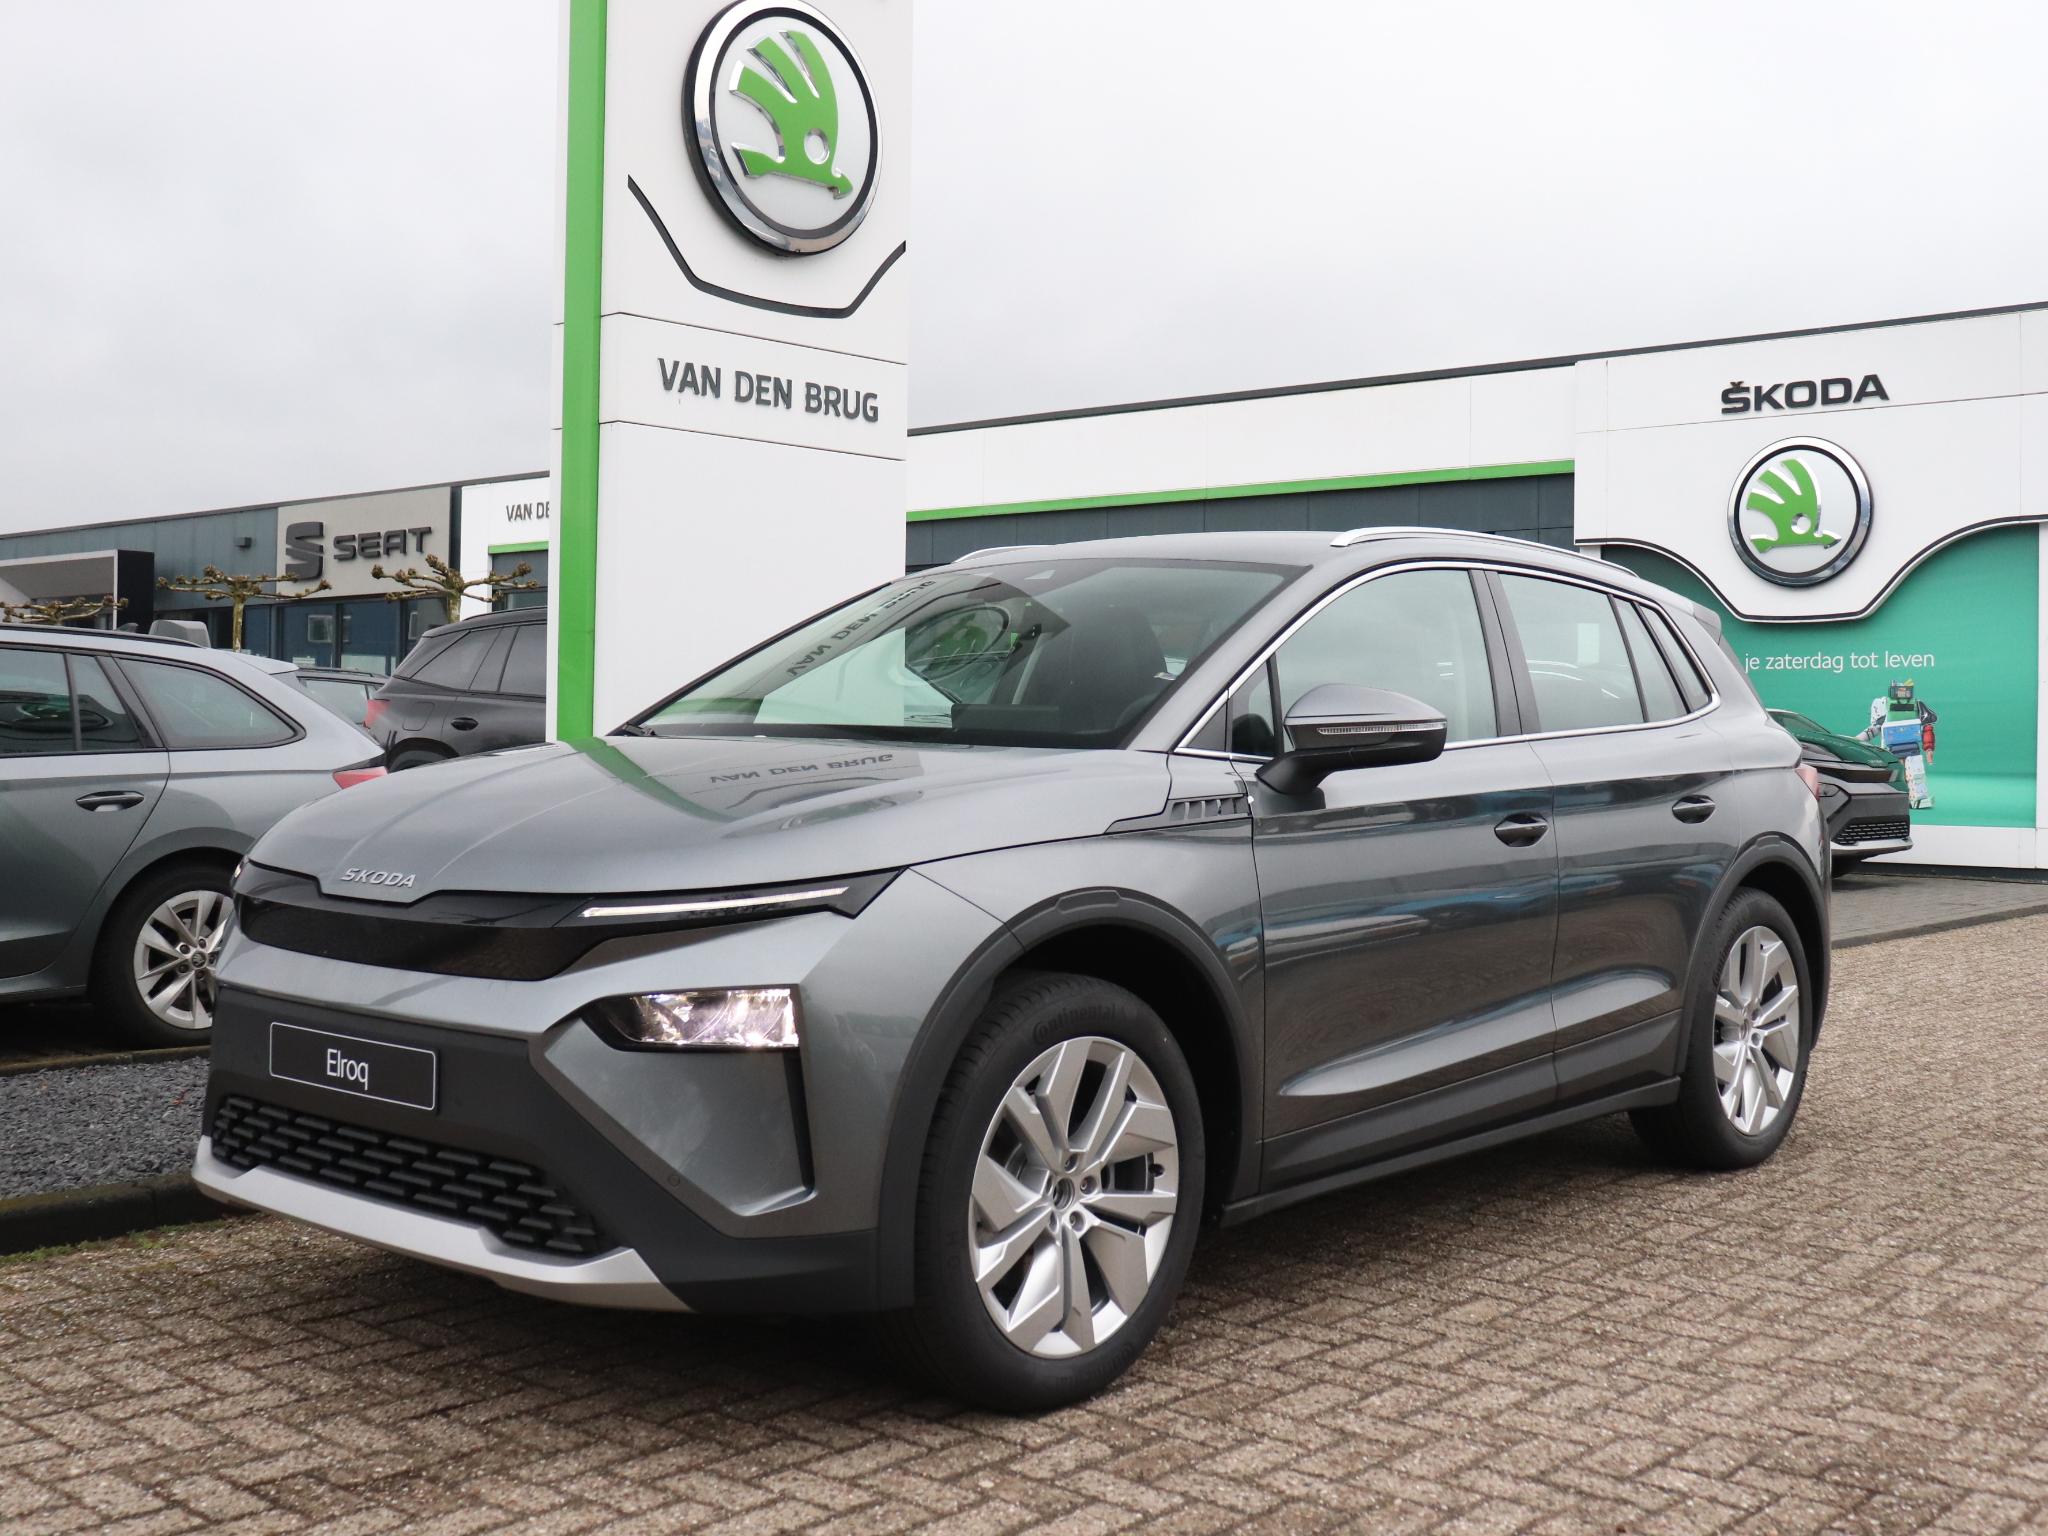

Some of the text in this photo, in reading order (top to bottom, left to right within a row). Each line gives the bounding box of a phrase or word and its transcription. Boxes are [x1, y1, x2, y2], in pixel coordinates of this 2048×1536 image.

[658, 357, 879, 423] VAN DEN BRUG
[1721, 373, 1890, 414] ŠKODA
[506, 503, 532, 522] VAN
[333, 526, 432, 561] SEAT
[1744, 650, 1935, 673] je zaterdag tot leven
[1032, 1004, 1116, 1044] Continental
[327, 1048, 369, 1091] Elroq
